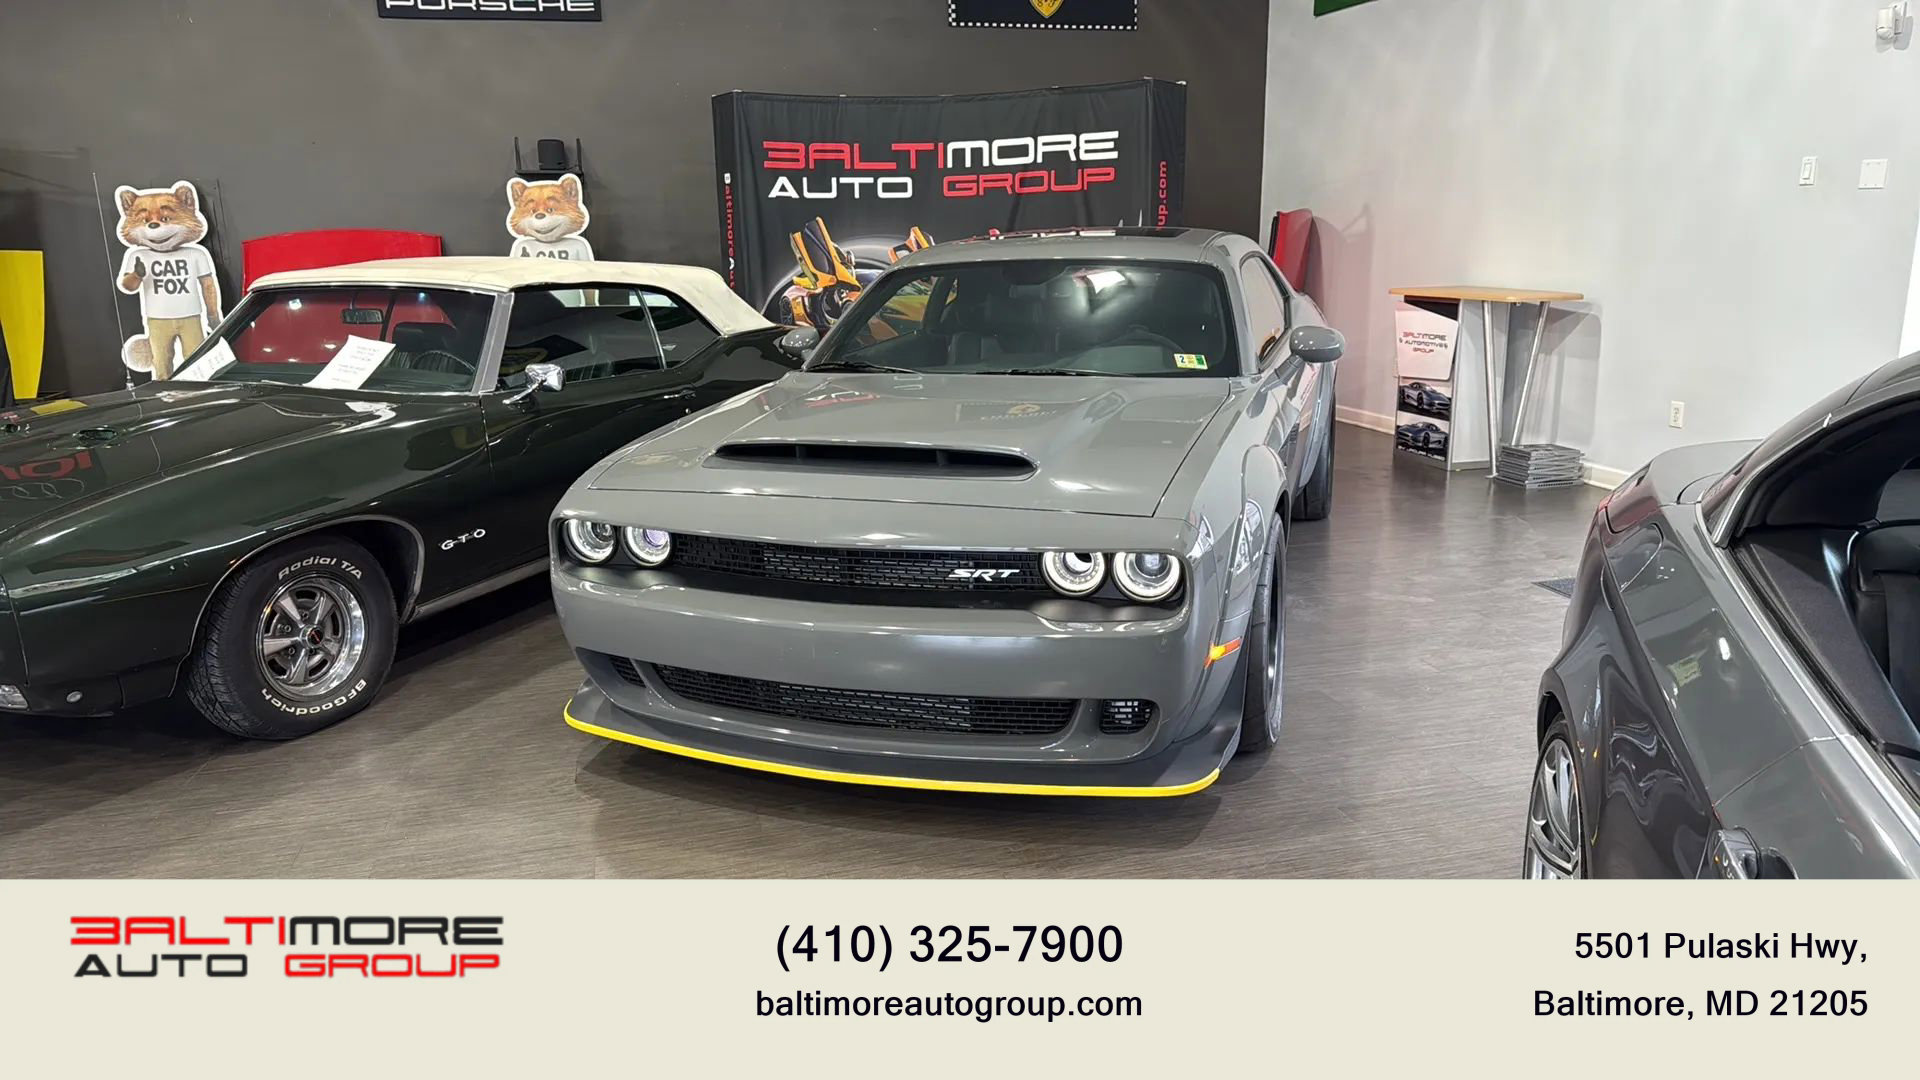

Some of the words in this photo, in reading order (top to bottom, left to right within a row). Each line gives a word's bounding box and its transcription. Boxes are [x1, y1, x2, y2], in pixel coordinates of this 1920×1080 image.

[386, 0, 595, 12] PORSCHE
[763, 130, 1119, 169] BALTIMORE
[768, 175, 913, 199] AUTO
[943, 167, 1115, 197] GROUP
[151, 260, 189, 277] CAR
[153, 278, 190, 294] FOX
[441, 529, 486, 550] GTO
[278, 556, 337, 580] Radial
[340, 560, 363, 579] T/A
[948, 569, 1020, 581] SRT
[261, 679, 367, 715] BFGoodrich
